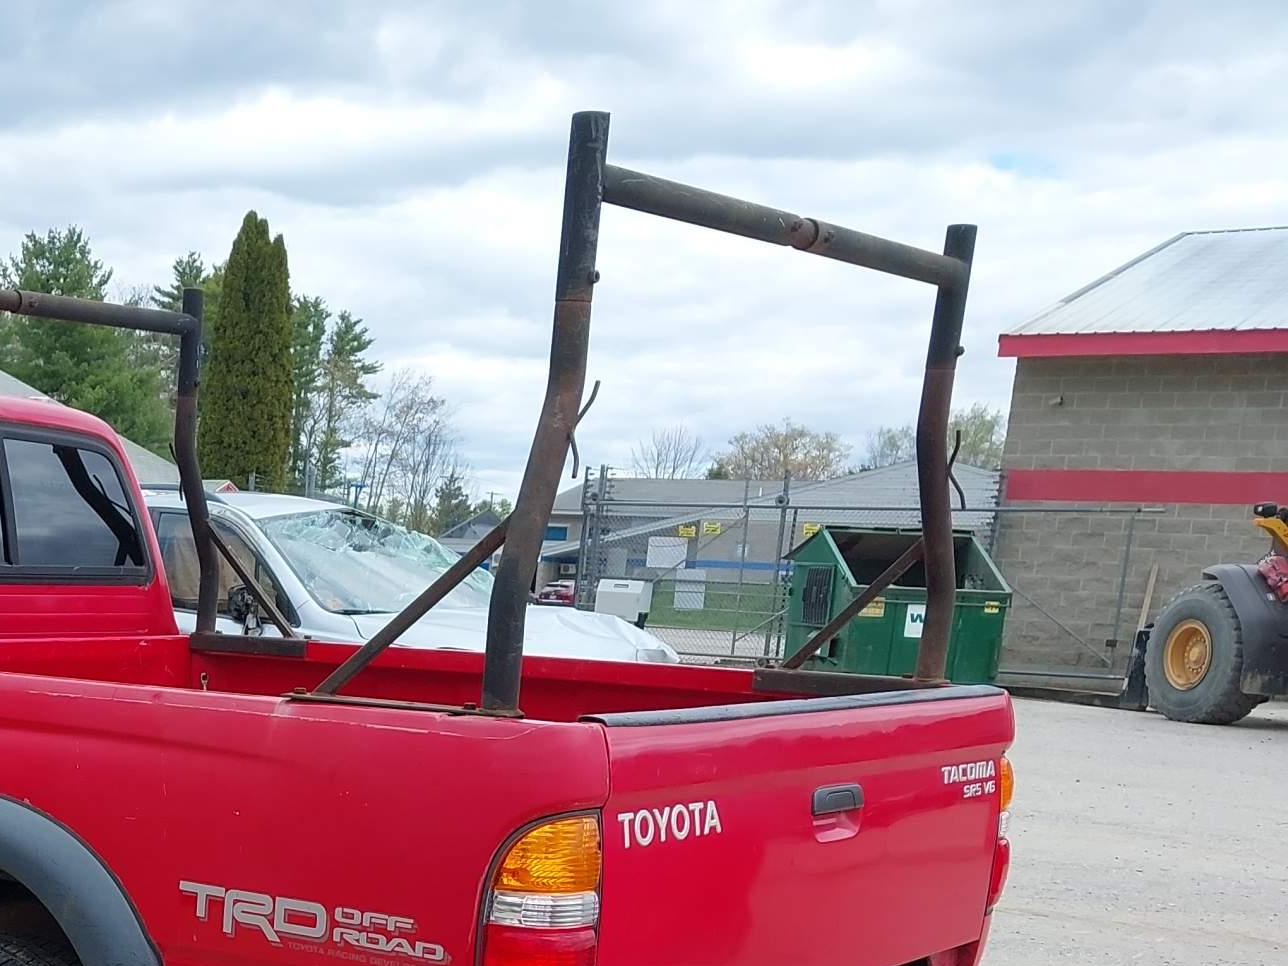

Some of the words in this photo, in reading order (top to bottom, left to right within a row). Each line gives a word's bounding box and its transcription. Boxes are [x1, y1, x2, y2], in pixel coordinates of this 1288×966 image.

[941, 760, 996, 785] TACOMA
[963, 782, 982, 798] SR5
[983, 780, 996, 795] V6
[617, 800, 722, 849] TOYOTA
[178, 879, 330, 946] TRD
[333, 906, 416, 933] OFF
[287, 941, 325, 955] TOYOTA
[327, 948, 367, 963] RACING
[332, 927, 450, 963] ROAD
